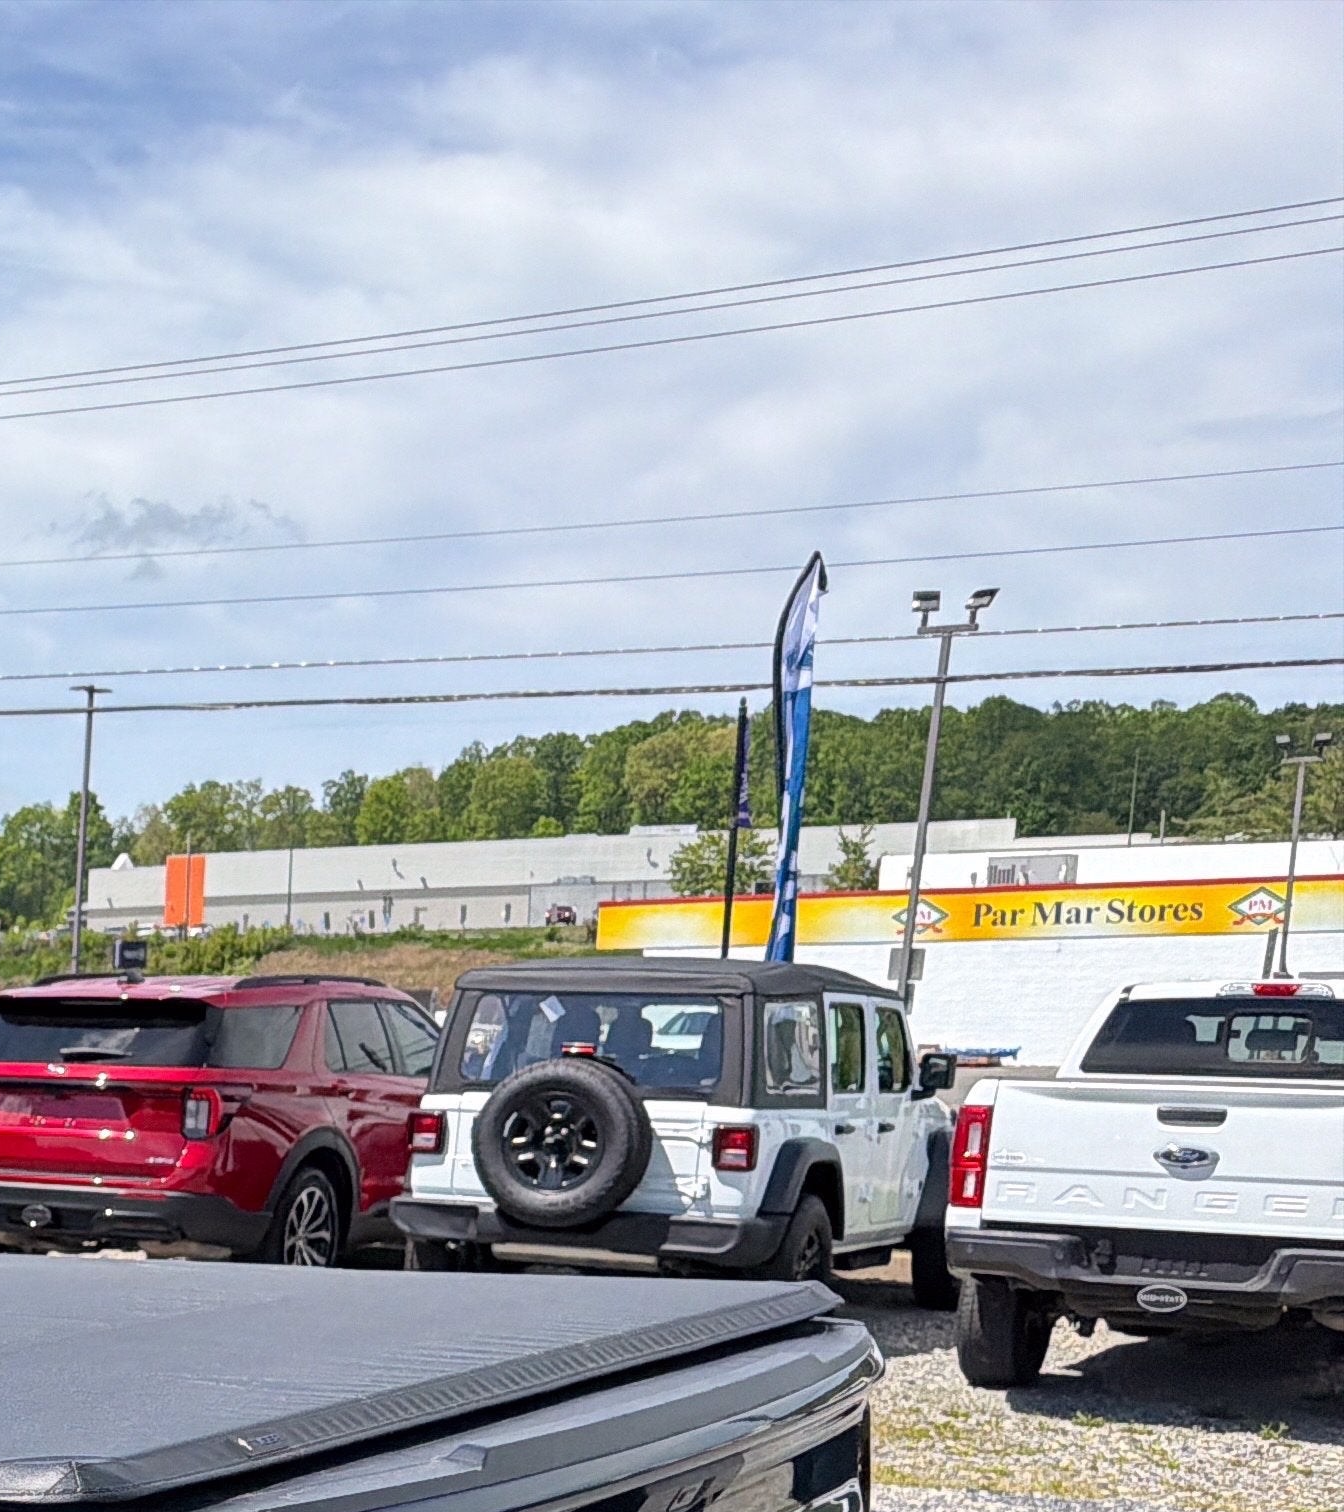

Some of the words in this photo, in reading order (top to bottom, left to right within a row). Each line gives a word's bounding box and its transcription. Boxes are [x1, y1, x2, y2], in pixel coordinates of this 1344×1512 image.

[972, 902, 1025, 928] Par
[1031, 900, 1101, 927] Mar
[1105, 898, 1204, 924] Stores
[1247, 899, 1273, 912] PM
